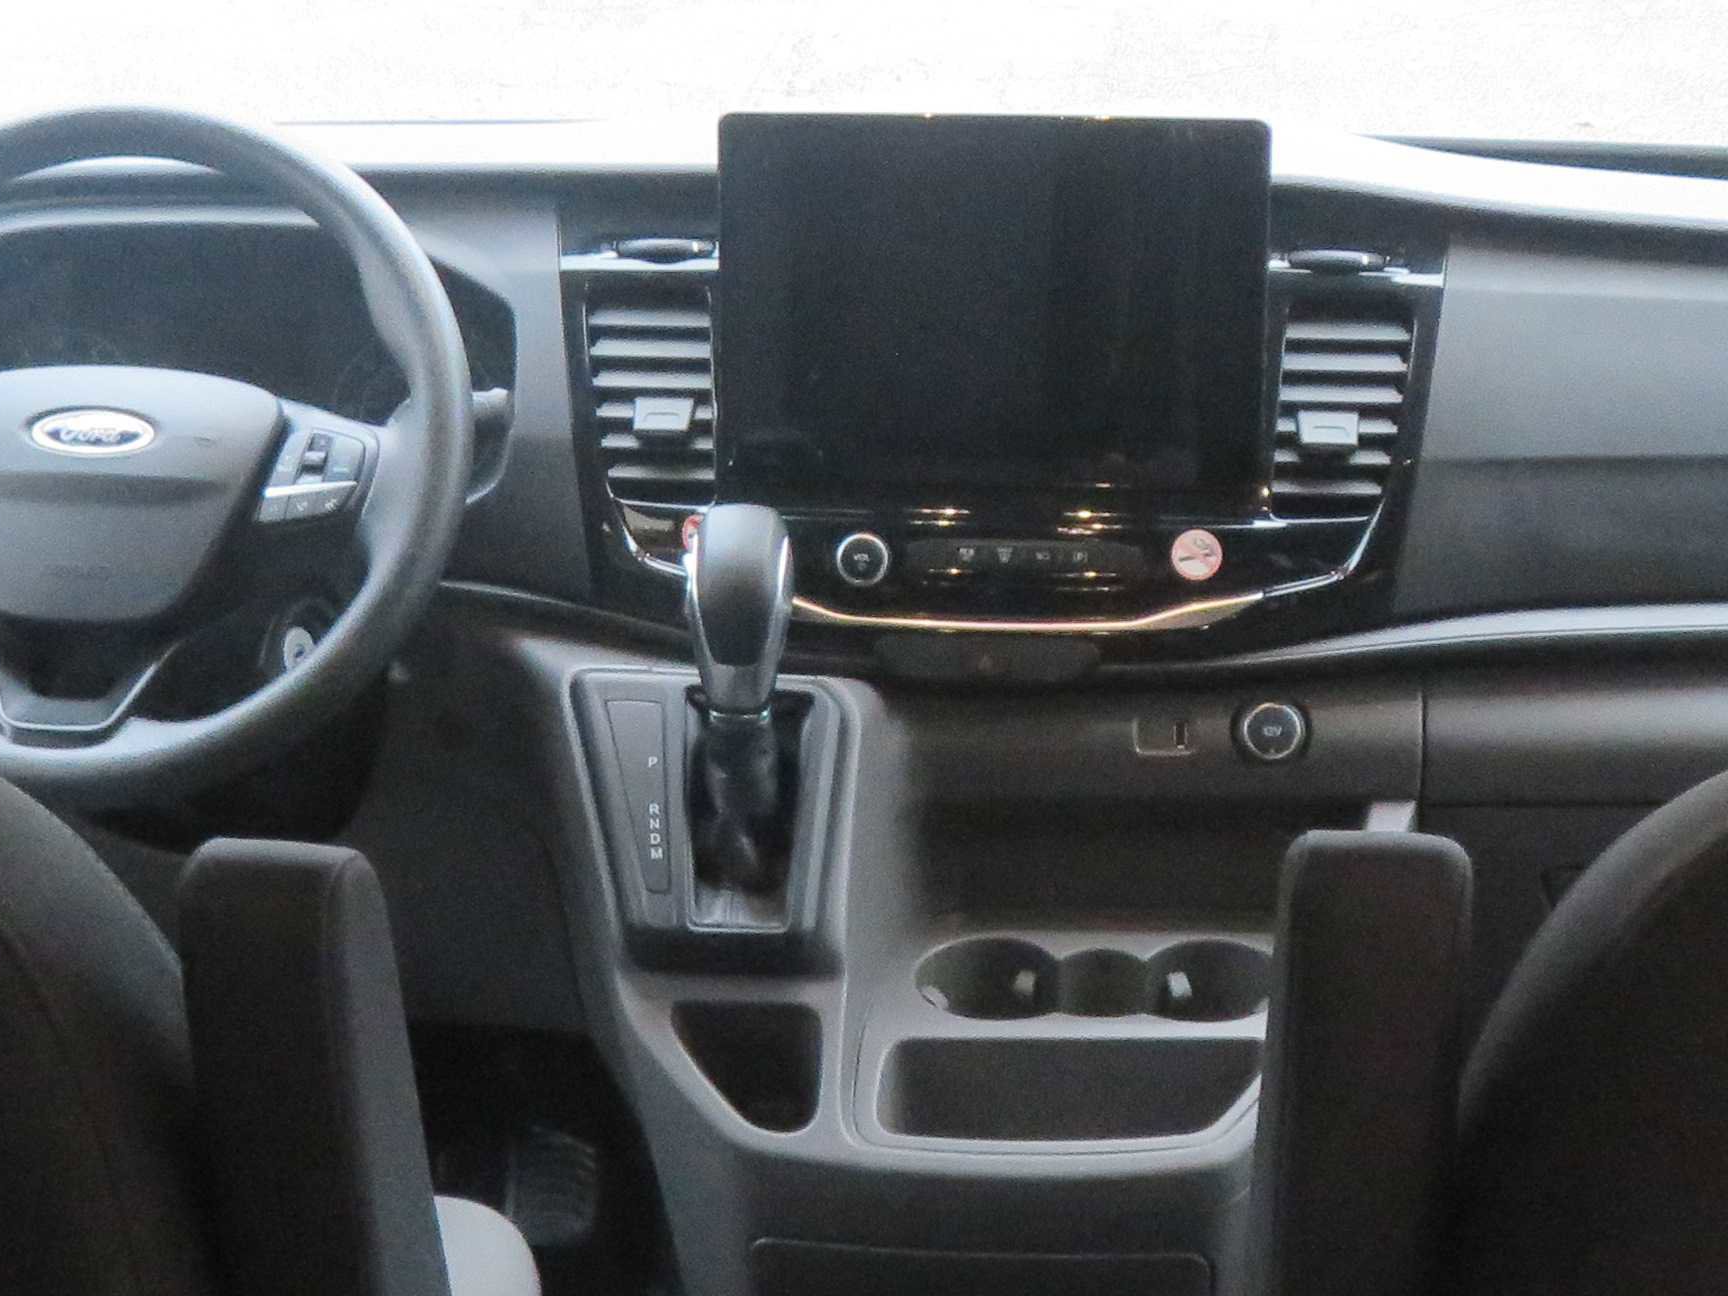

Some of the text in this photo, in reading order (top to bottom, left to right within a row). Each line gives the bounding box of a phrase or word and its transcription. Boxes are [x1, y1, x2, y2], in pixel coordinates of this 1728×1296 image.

[648, 756, 658, 768] P
[648, 803, 660, 815] R
[649, 818, 660, 830] N
[650, 833, 661, 845] D
[650, 847, 663, 860] M
